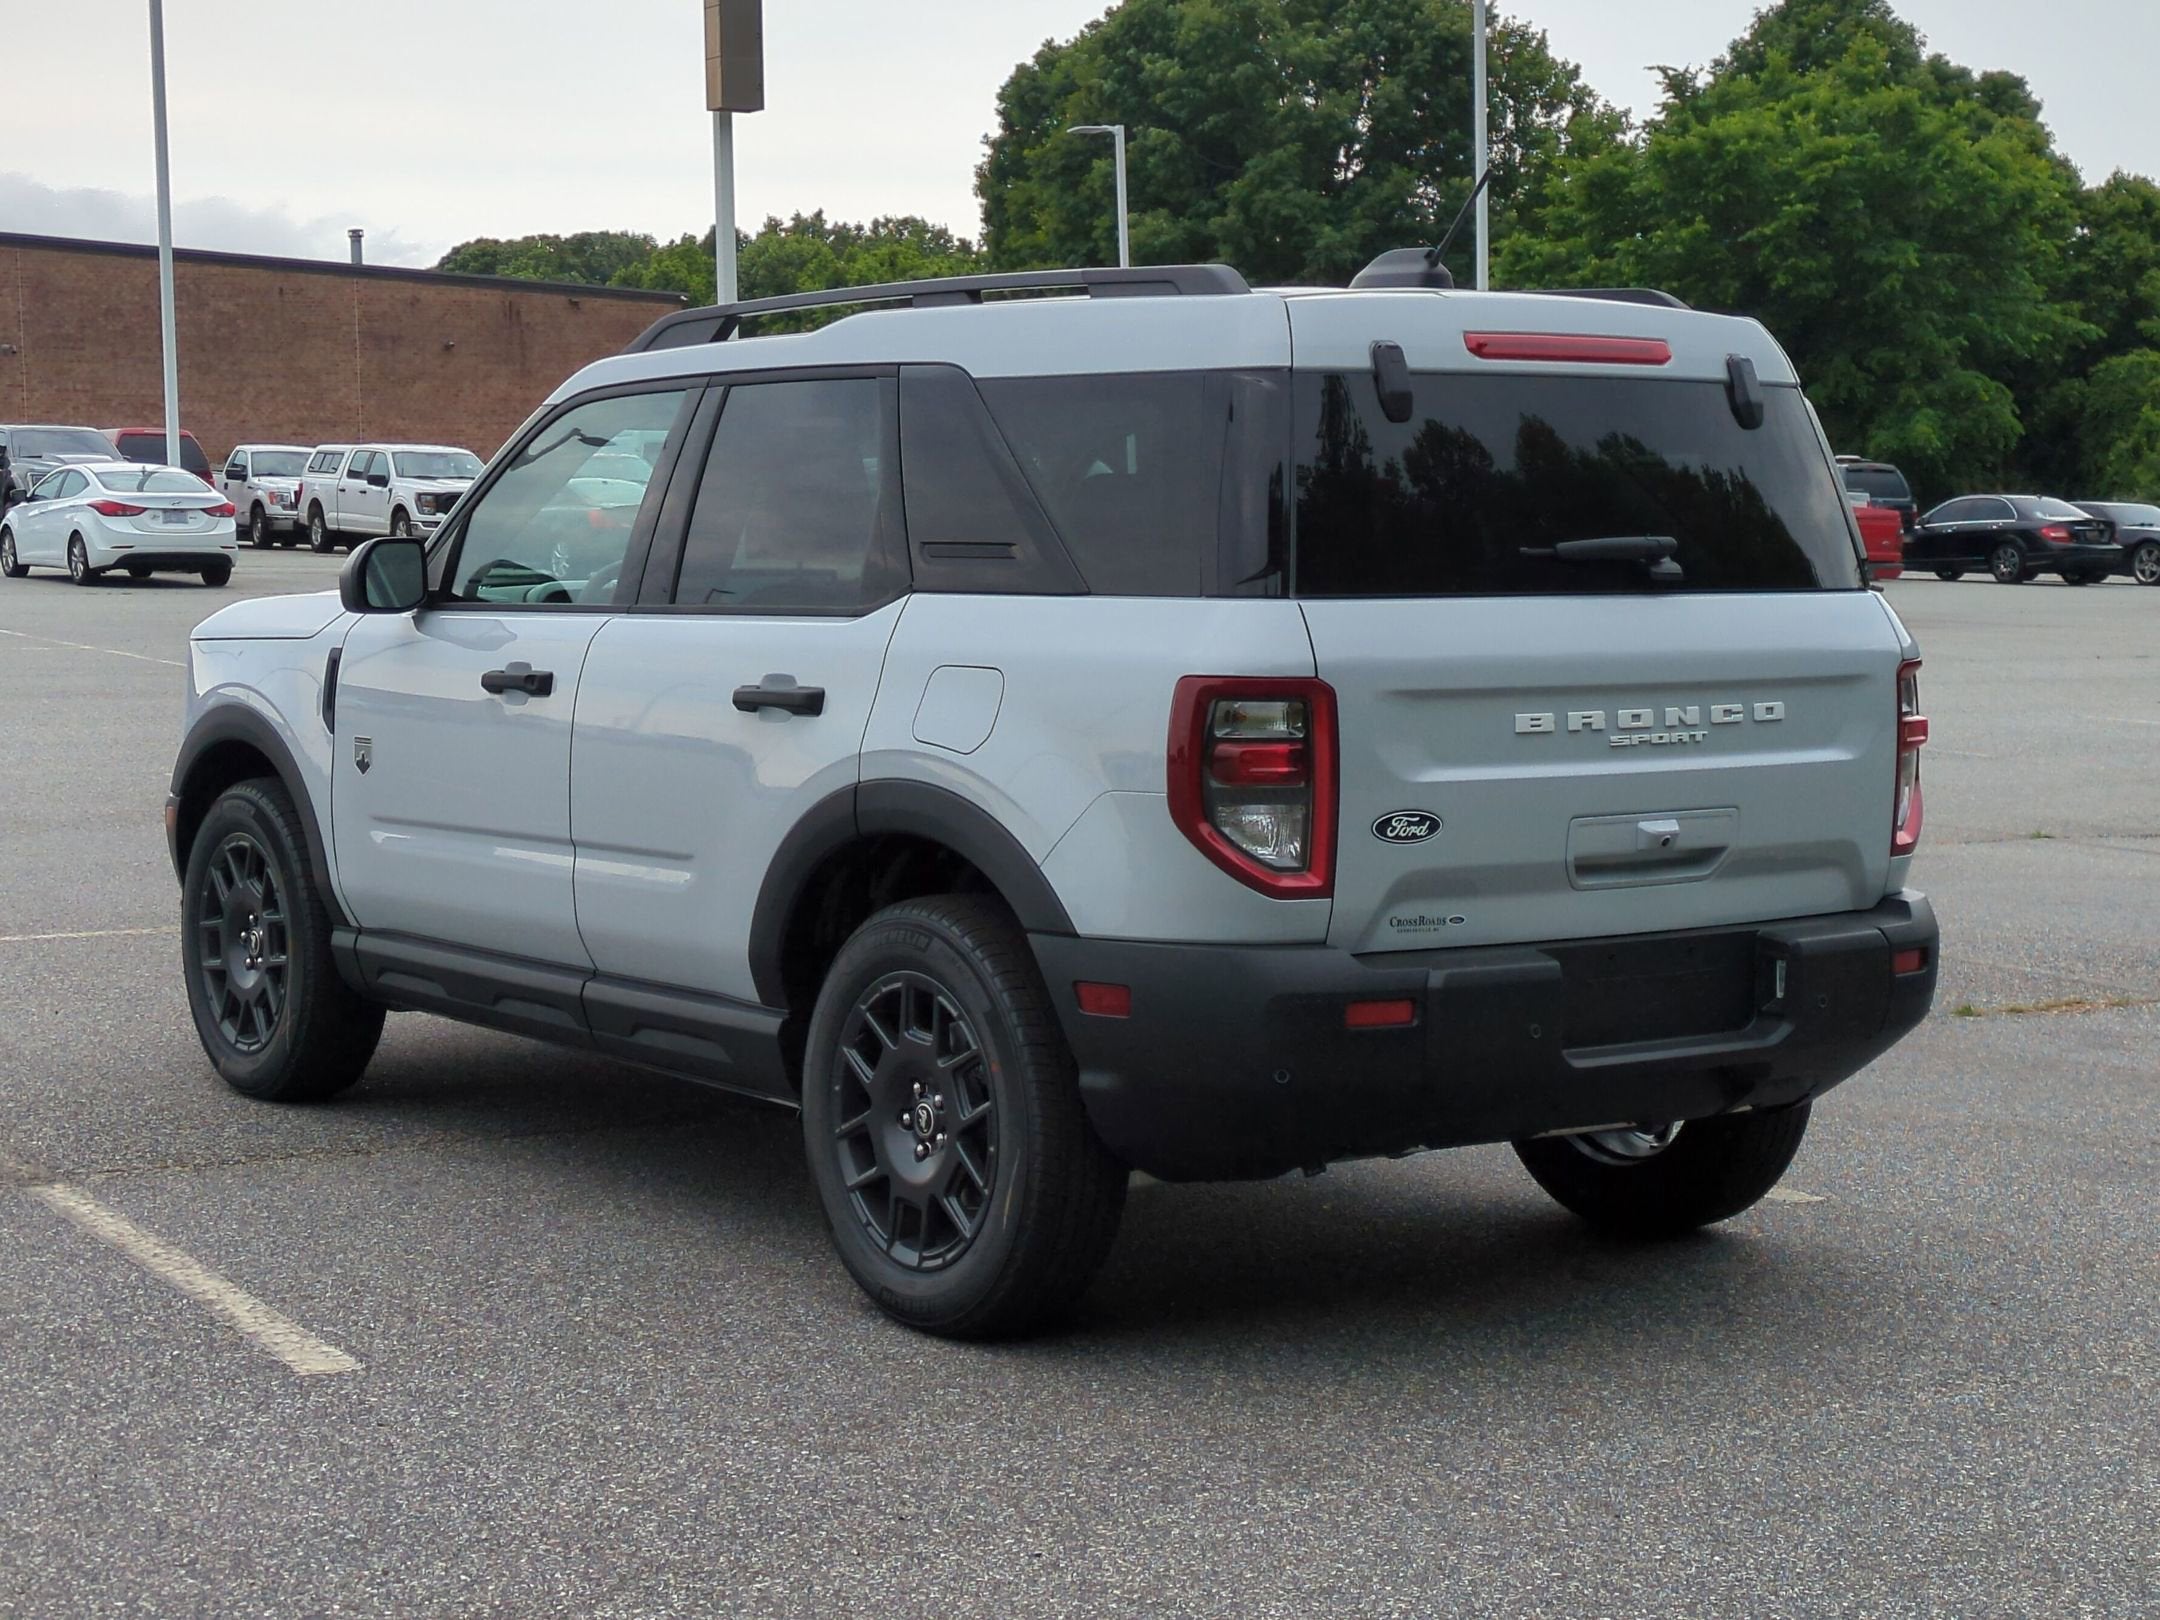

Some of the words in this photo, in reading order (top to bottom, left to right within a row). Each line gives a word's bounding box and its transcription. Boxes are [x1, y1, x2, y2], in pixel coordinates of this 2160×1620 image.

[1515, 701, 1785, 733] BRONCO
[1609, 731, 1709, 746] SPORT
[1387, 816, 1430, 837] Ford
